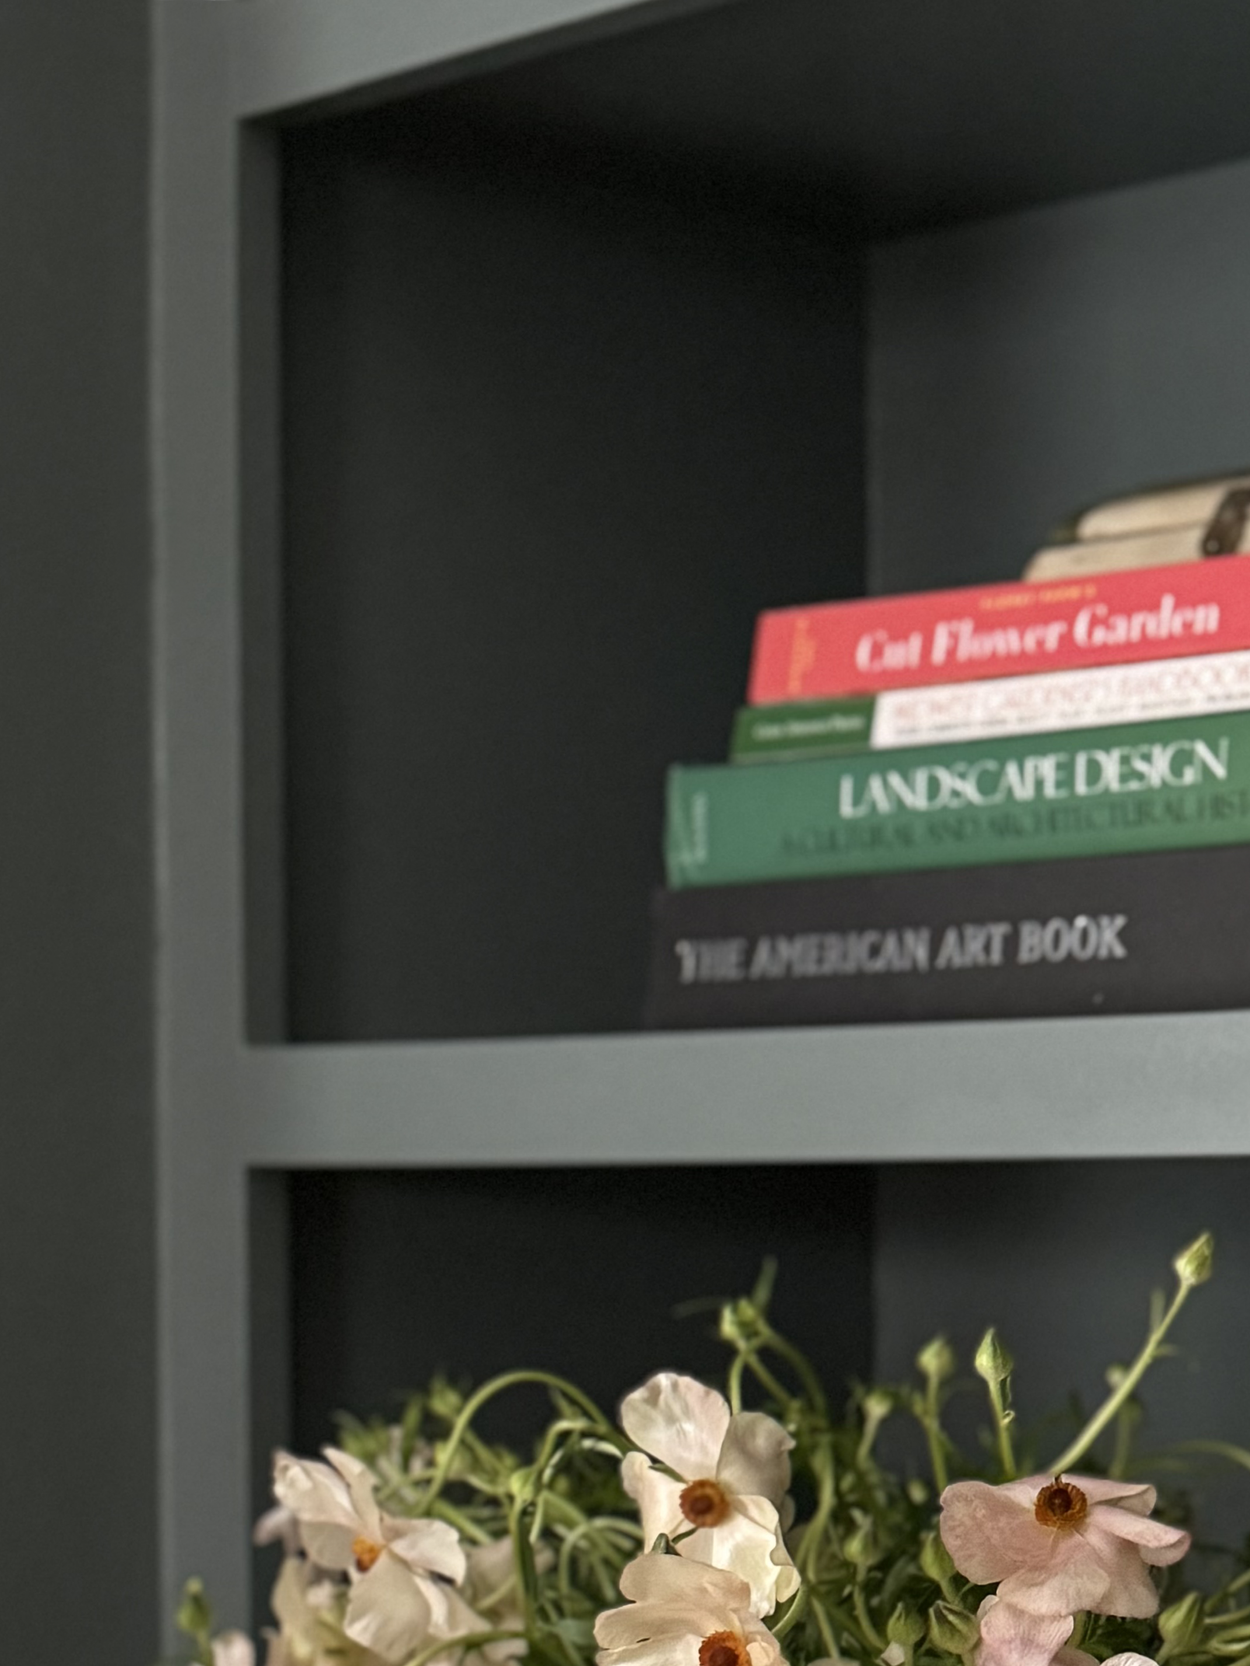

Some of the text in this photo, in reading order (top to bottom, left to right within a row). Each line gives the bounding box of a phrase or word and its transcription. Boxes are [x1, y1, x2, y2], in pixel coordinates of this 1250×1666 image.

[856, 629, 923, 673] Cut
[931, 616, 1068, 664] Flower
[1072, 592, 1221, 649] Garden
[839, 736, 1230, 820] LANDSCAPE DESIGN
[928, 813, 981, 843] AND
[675, 913, 1128, 984] THE AMERICAN ART BOOK
